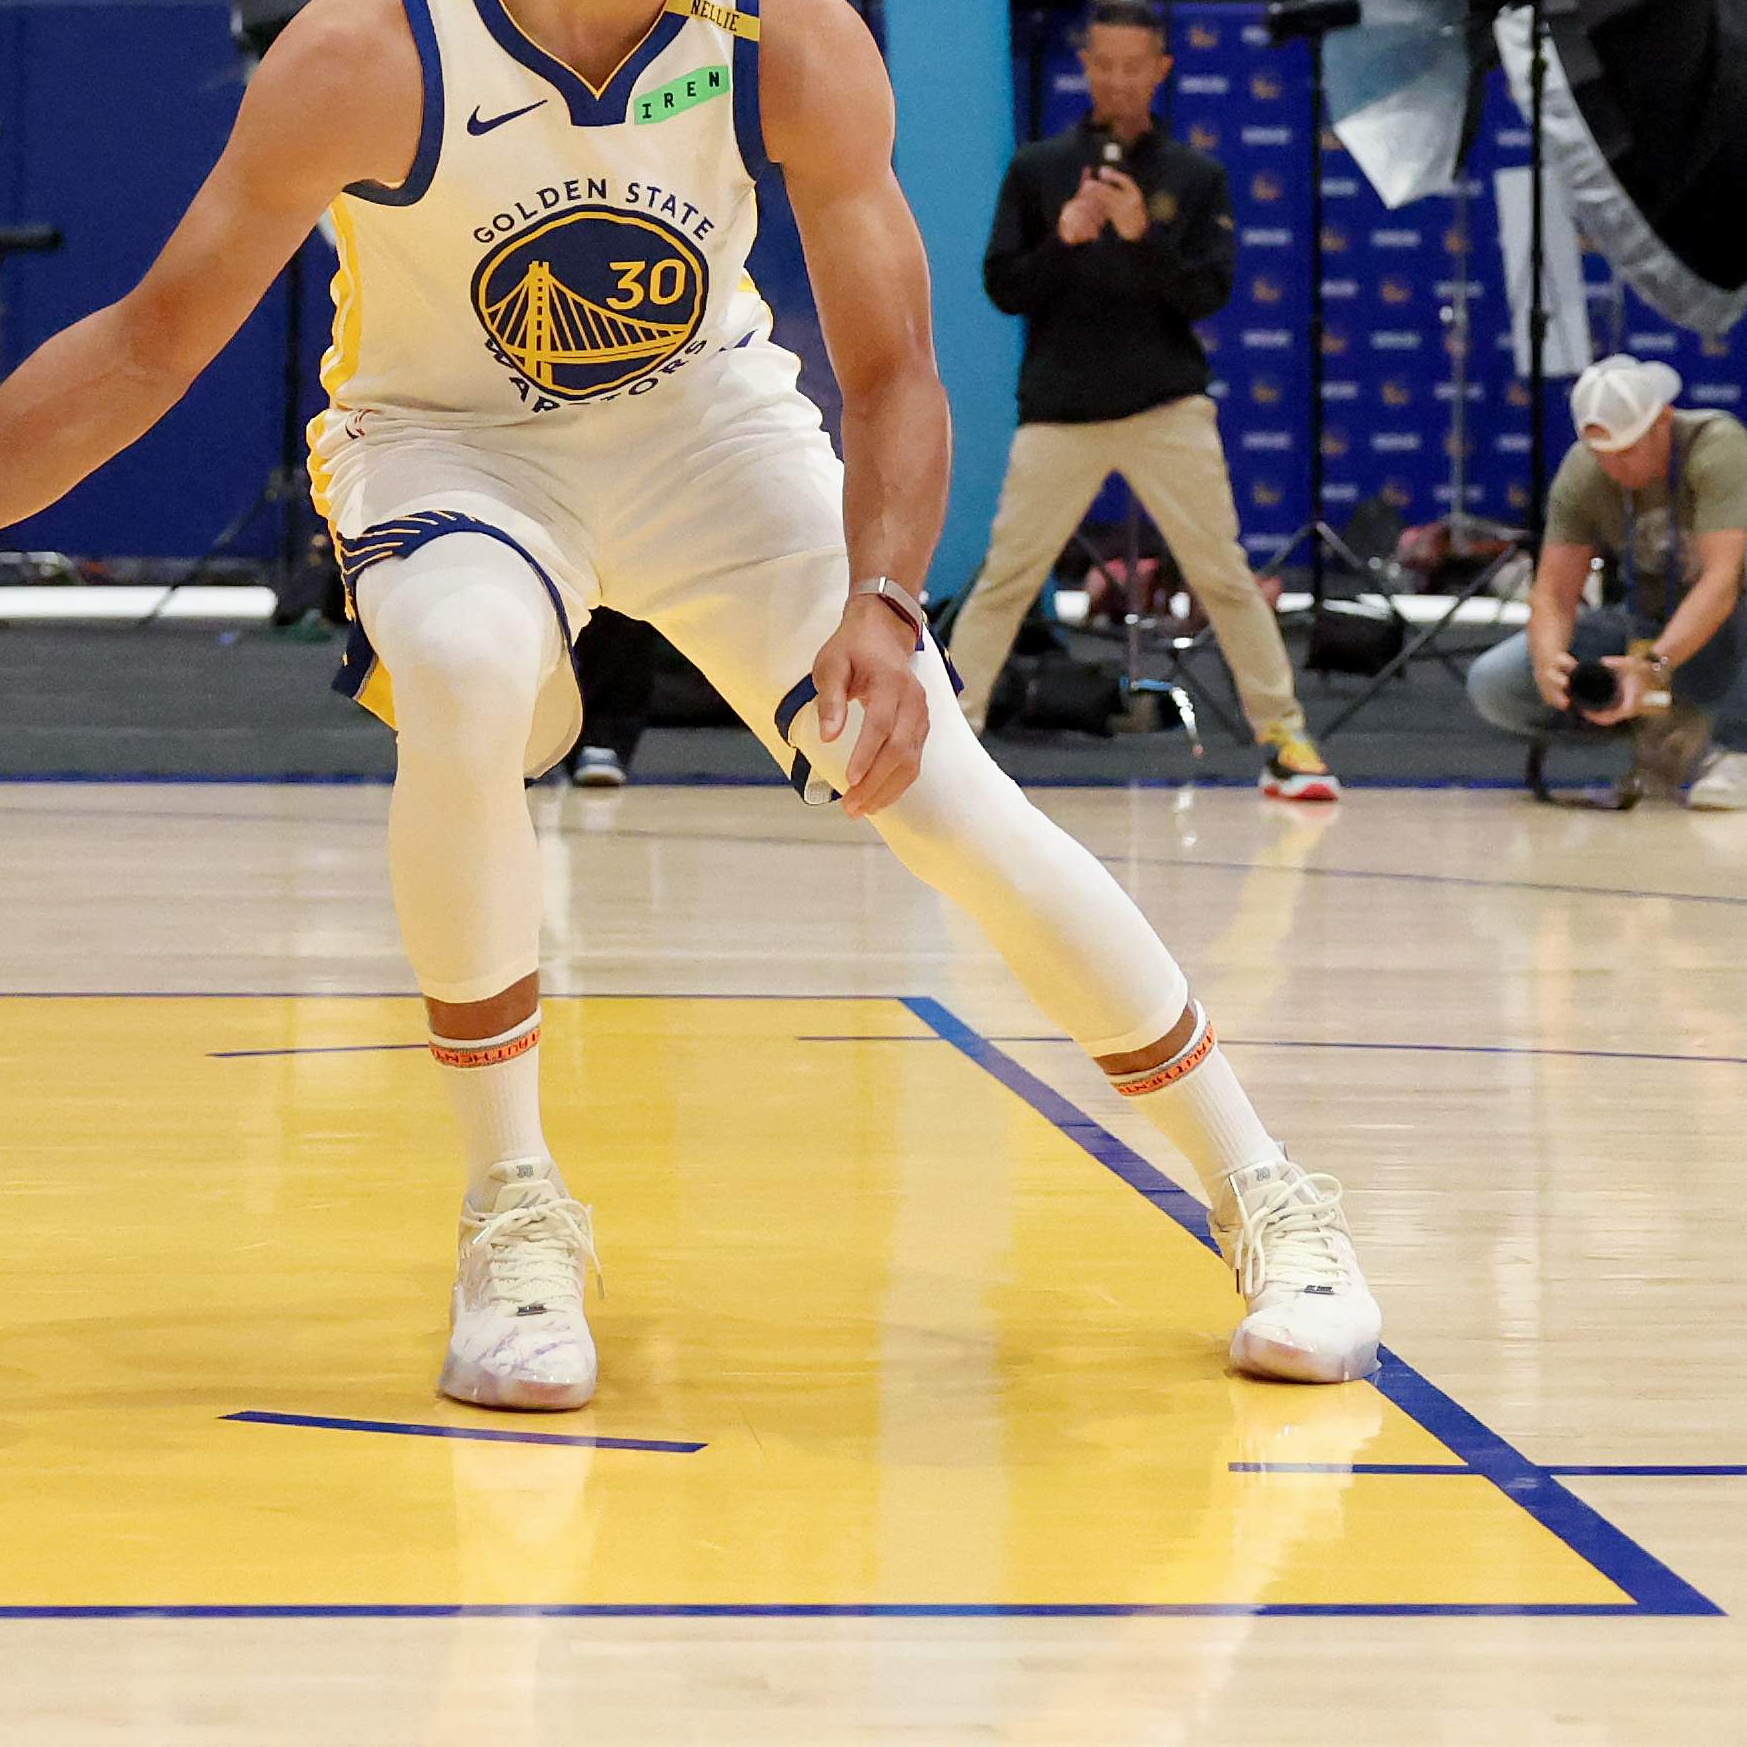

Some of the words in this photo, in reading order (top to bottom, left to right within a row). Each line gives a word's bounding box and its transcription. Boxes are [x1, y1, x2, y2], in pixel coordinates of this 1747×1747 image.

[642, 71, 721, 119] IREN
[474, 177, 607, 244] GOLDEN
[626, 181, 715, 241] STATE
[606, 259, 686, 310] 30
